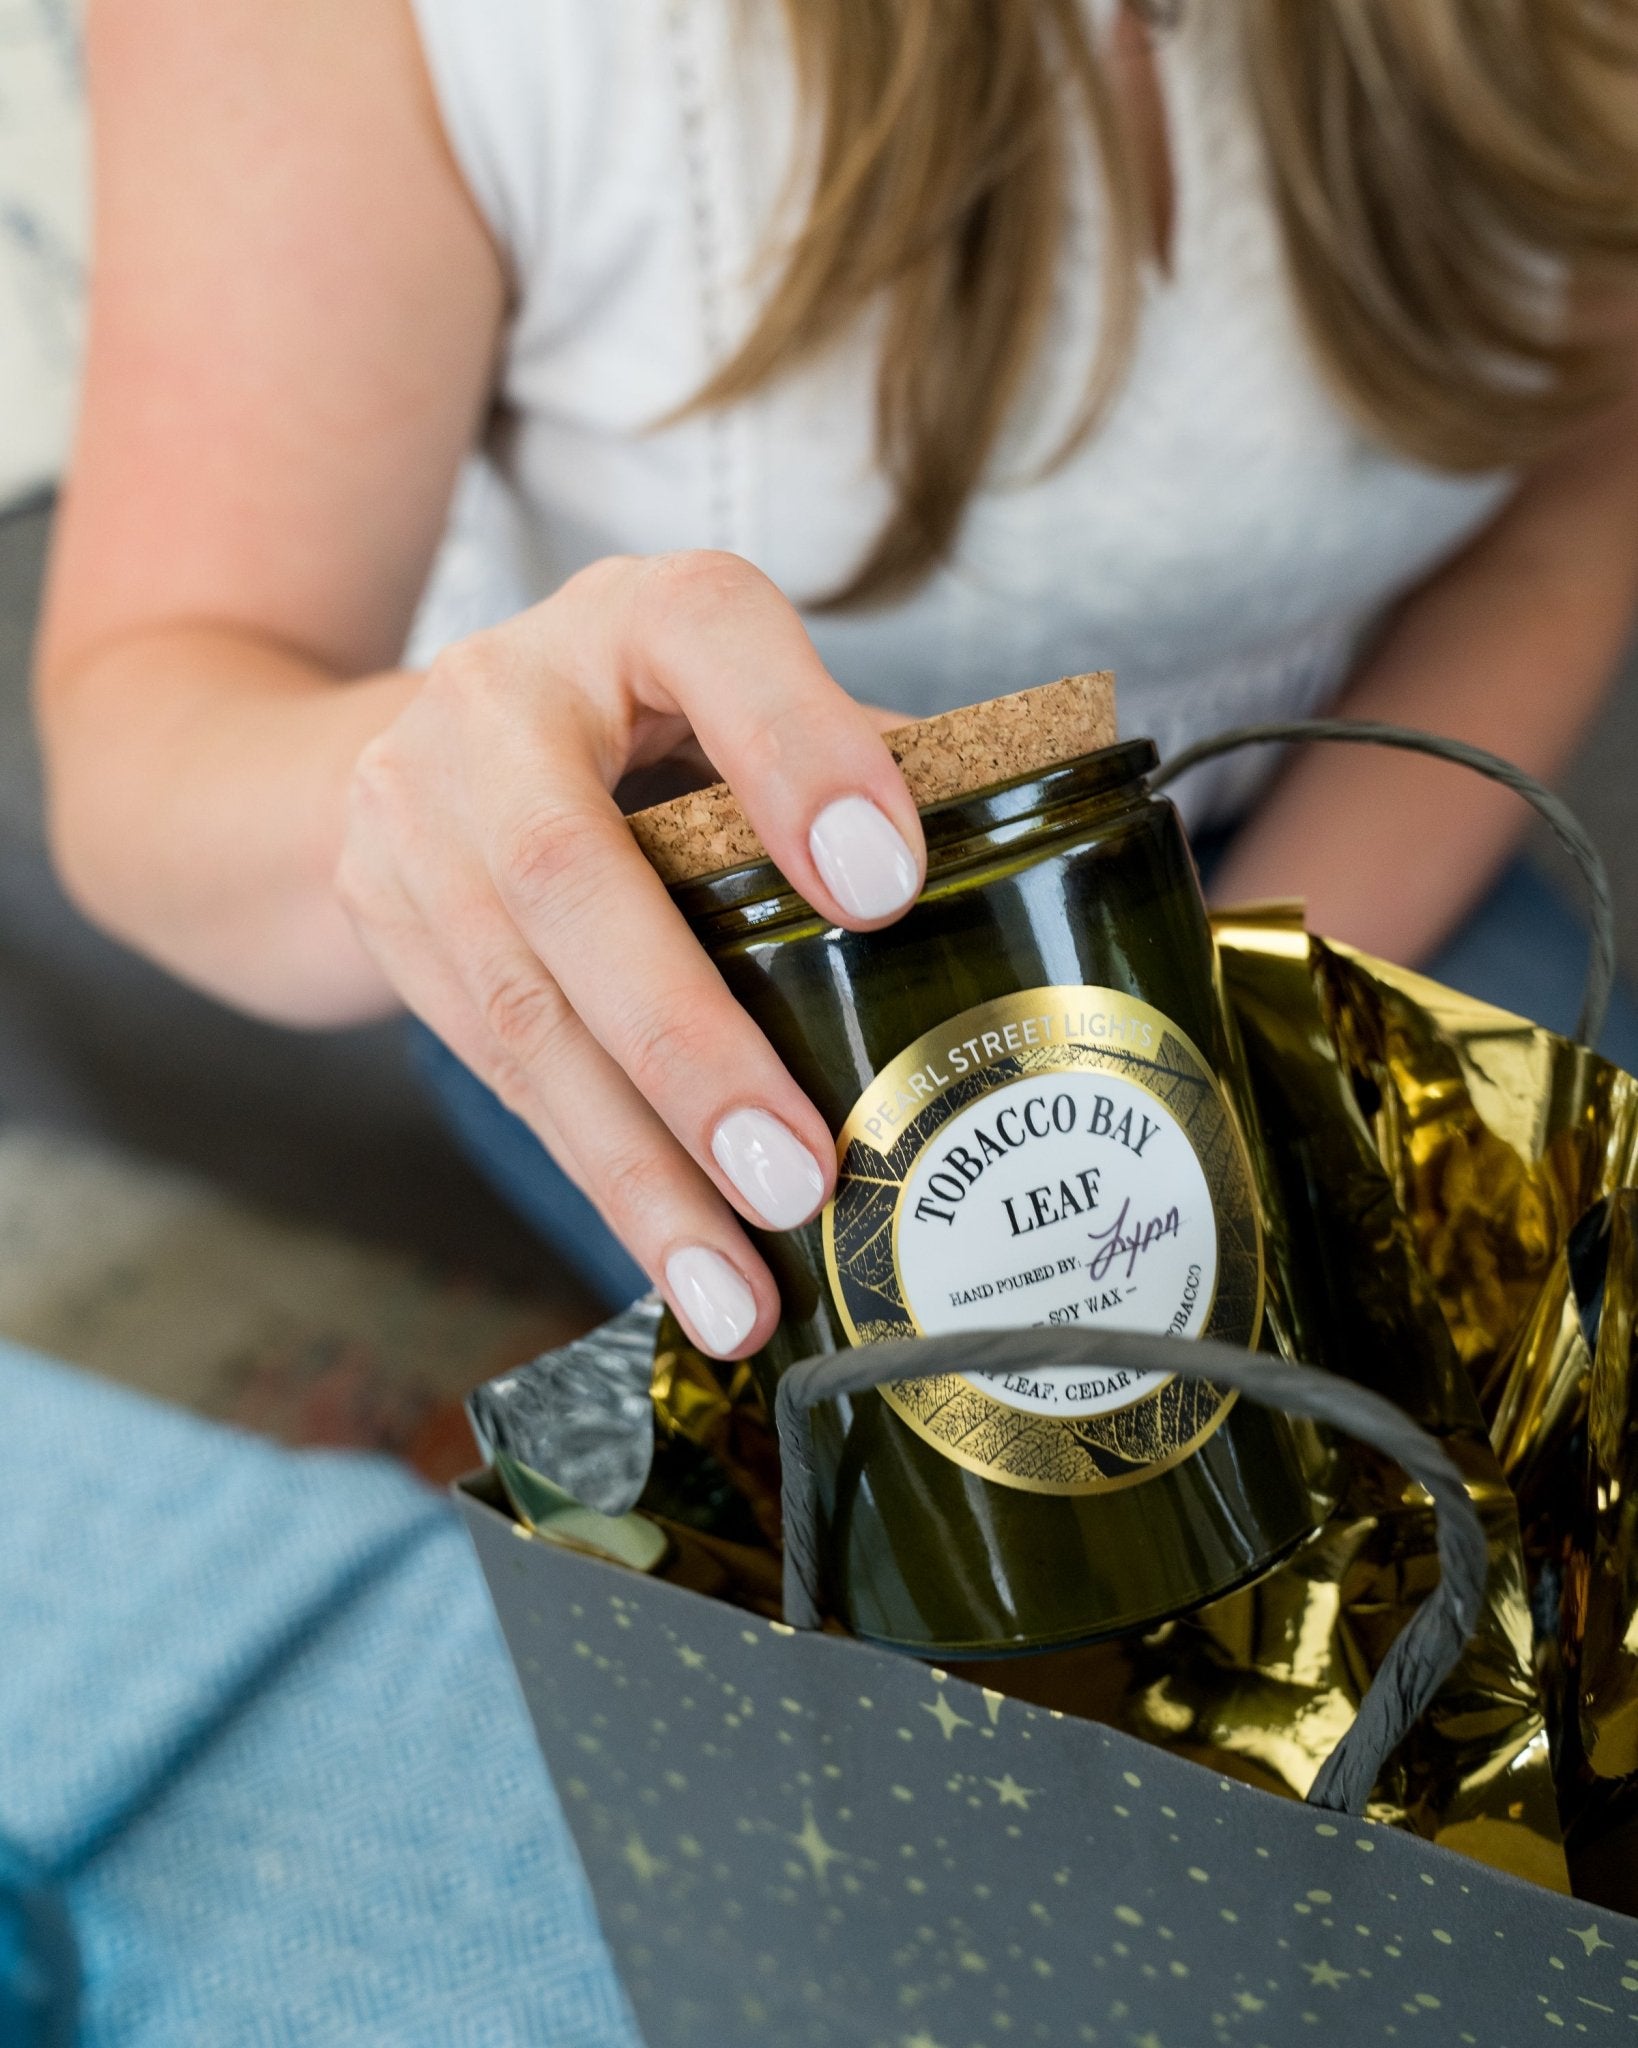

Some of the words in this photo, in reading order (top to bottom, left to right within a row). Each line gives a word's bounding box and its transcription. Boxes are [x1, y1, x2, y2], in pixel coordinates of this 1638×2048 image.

[864, 1063, 949, 1140] PEARL
[947, 1016, 1054, 1074] STREET
[1065, 1013, 1153, 1048] LIGHTS
[914, 1093, 1077, 1227] TOBACCO
[1086, 1094, 1161, 1158] BAY
[1001, 1167, 1102, 1237] LEAF
[949, 1282, 994, 1306] HAND
[996, 1267, 1055, 1294] POURED
[1048, 1303, 1080, 1327] SOY
[1083, 1287, 1123, 1314] WAX
[1002, 1372, 1059, 1403] LEAF,
[1065, 1370, 1131, 1401] CEDAR
